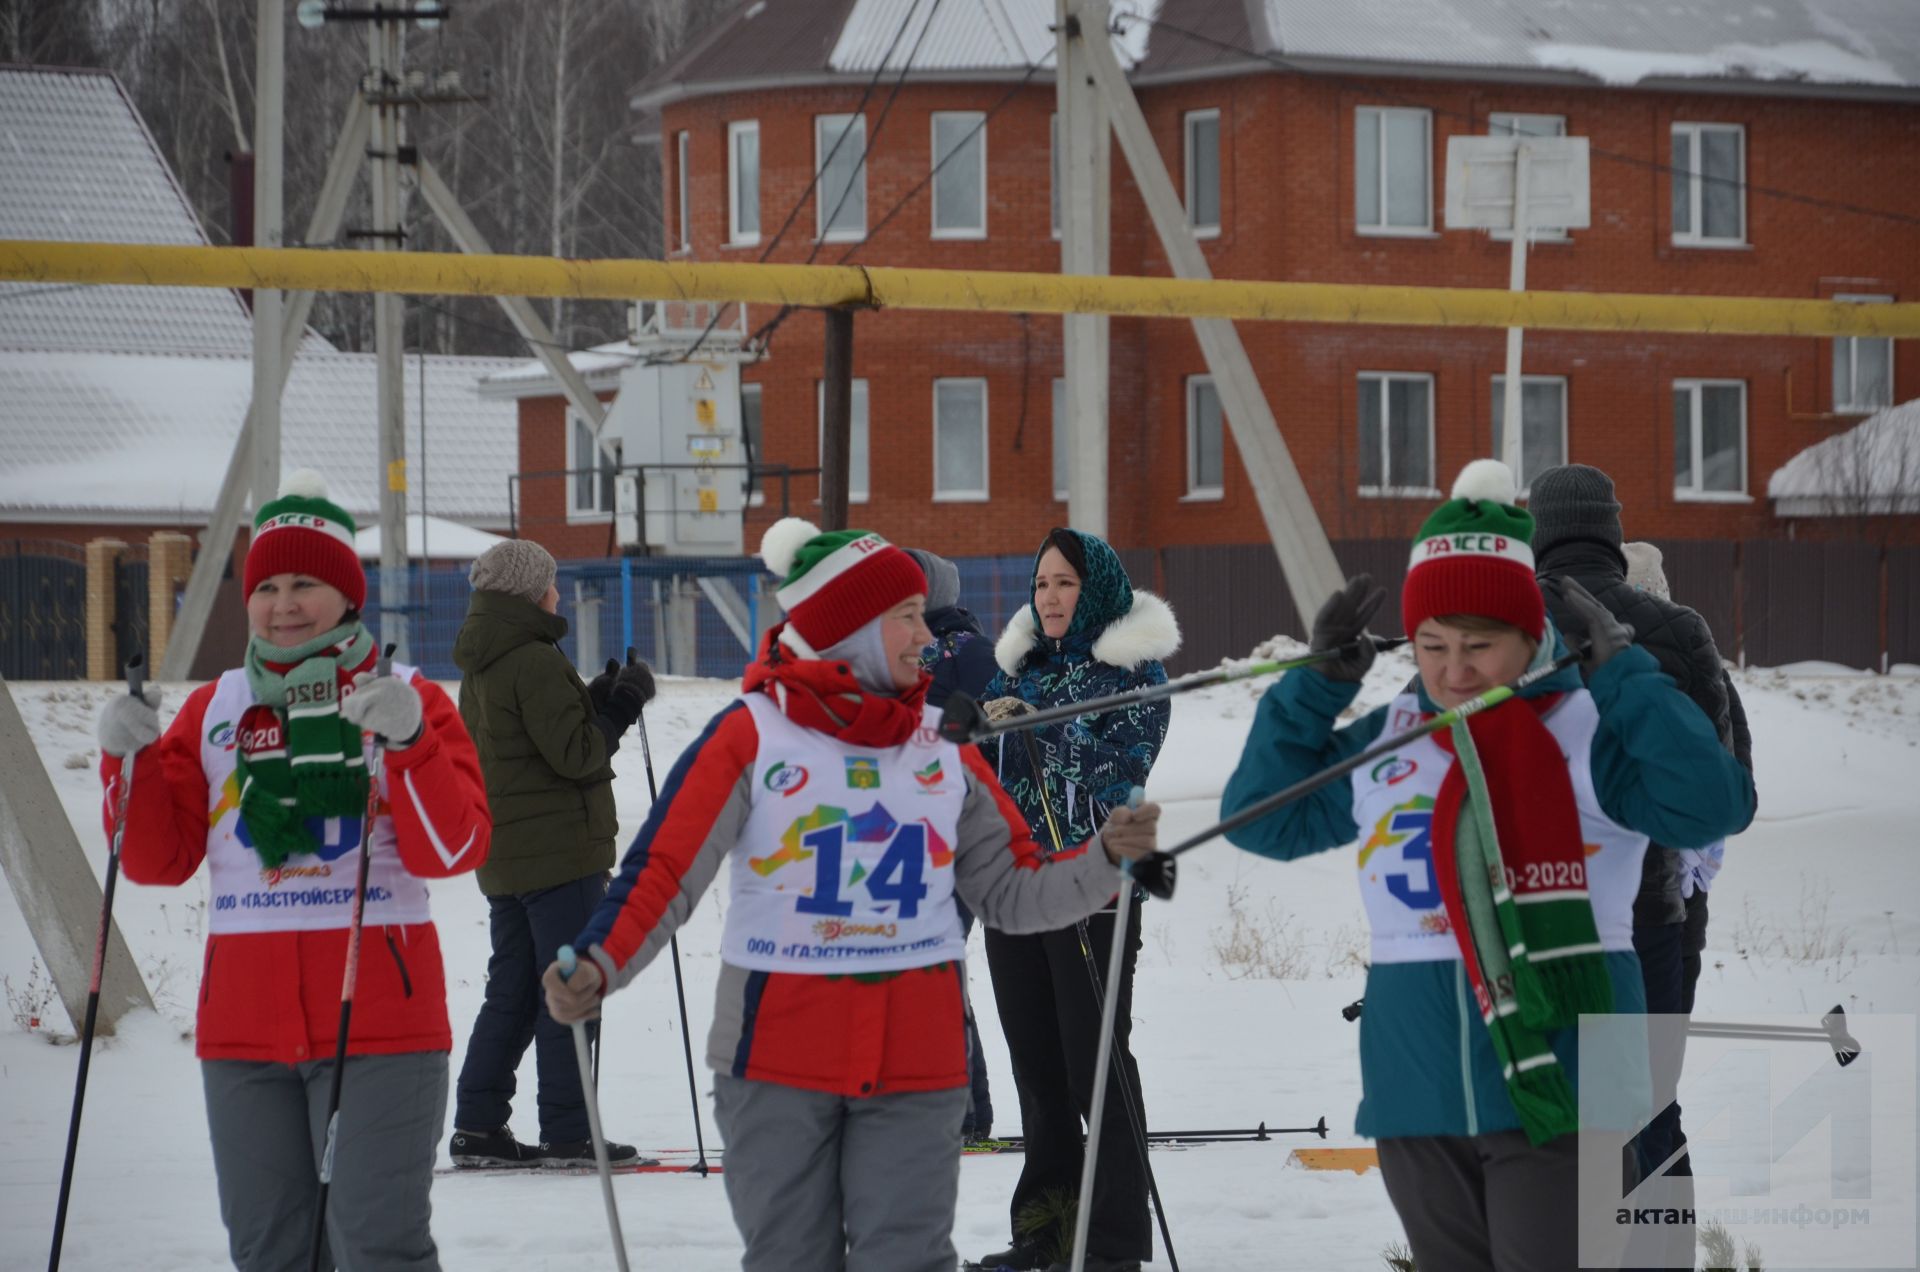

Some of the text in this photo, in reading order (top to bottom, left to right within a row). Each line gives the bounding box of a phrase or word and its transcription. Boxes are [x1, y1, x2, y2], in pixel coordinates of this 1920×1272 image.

[795, 824, 928, 919] 14
[240, 886, 392, 909] «ГАЗСТРОЙСЕРИС»
[747, 938, 776, 956] ООО
